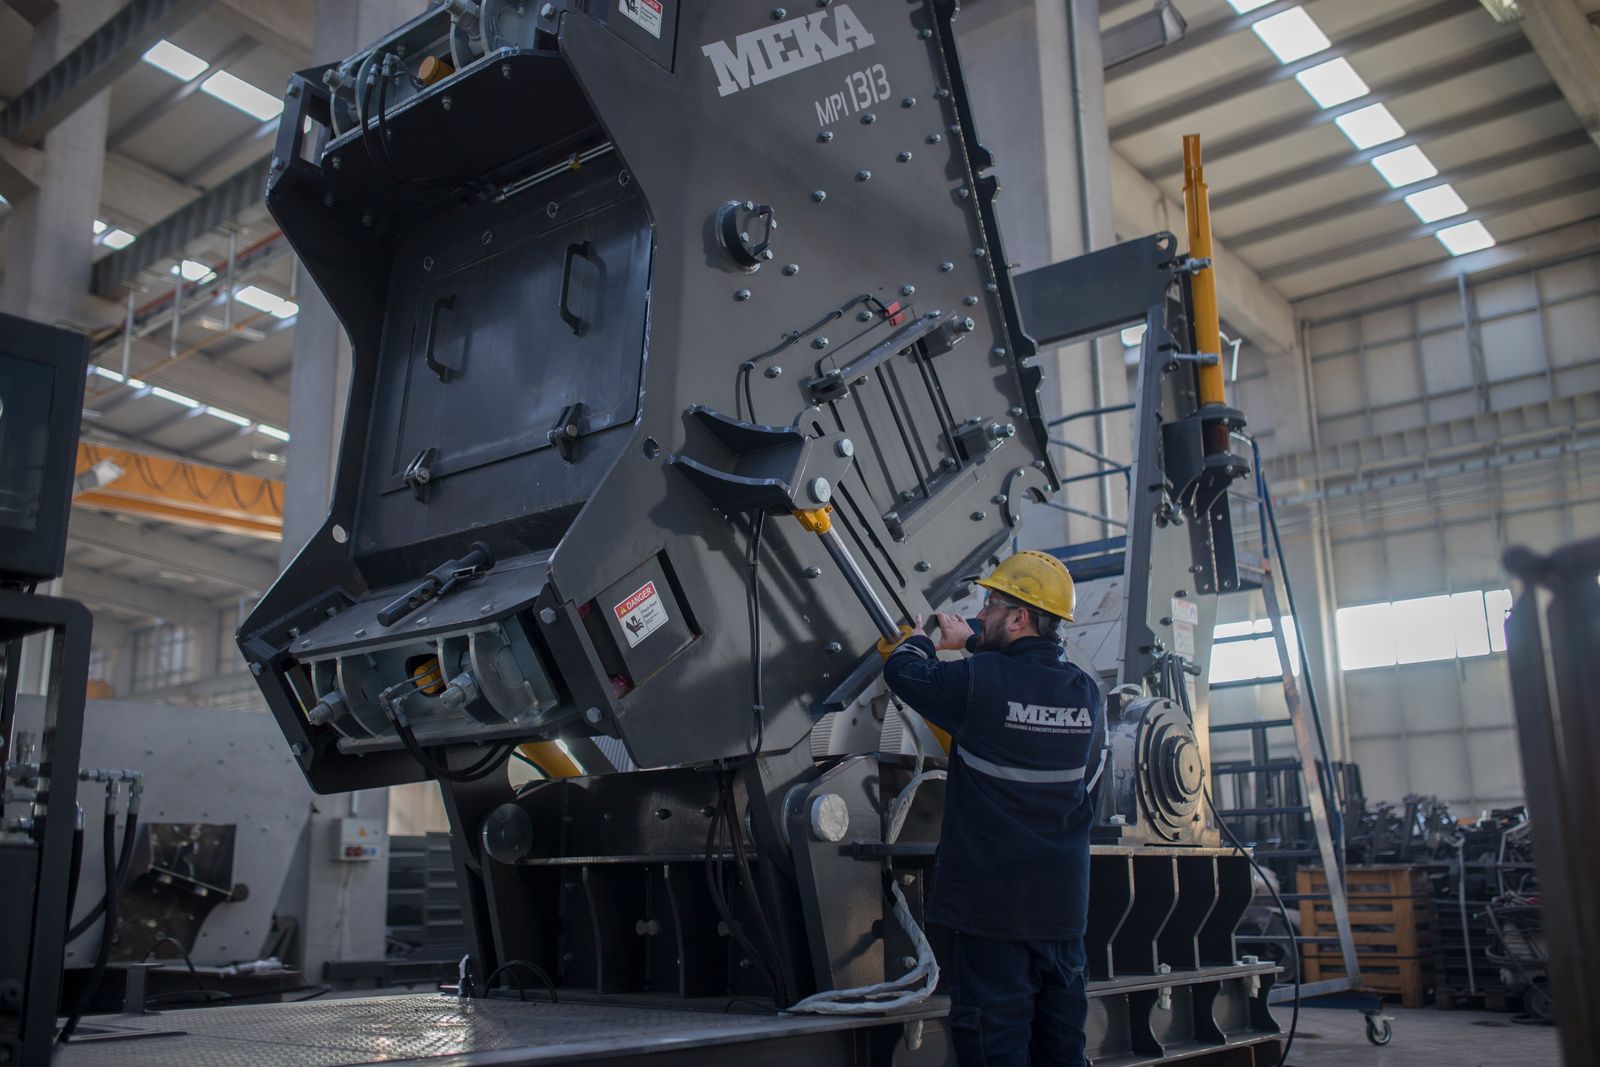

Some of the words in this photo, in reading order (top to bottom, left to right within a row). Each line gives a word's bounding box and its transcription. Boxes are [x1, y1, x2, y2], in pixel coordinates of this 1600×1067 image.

[701, 4, 876, 97] MEKA
[815, 91, 849, 126] MPI
[845, 63, 891, 112] 1313
[626, 587, 653, 610] DANGER
[1006, 701, 1092, 727] MEKA
